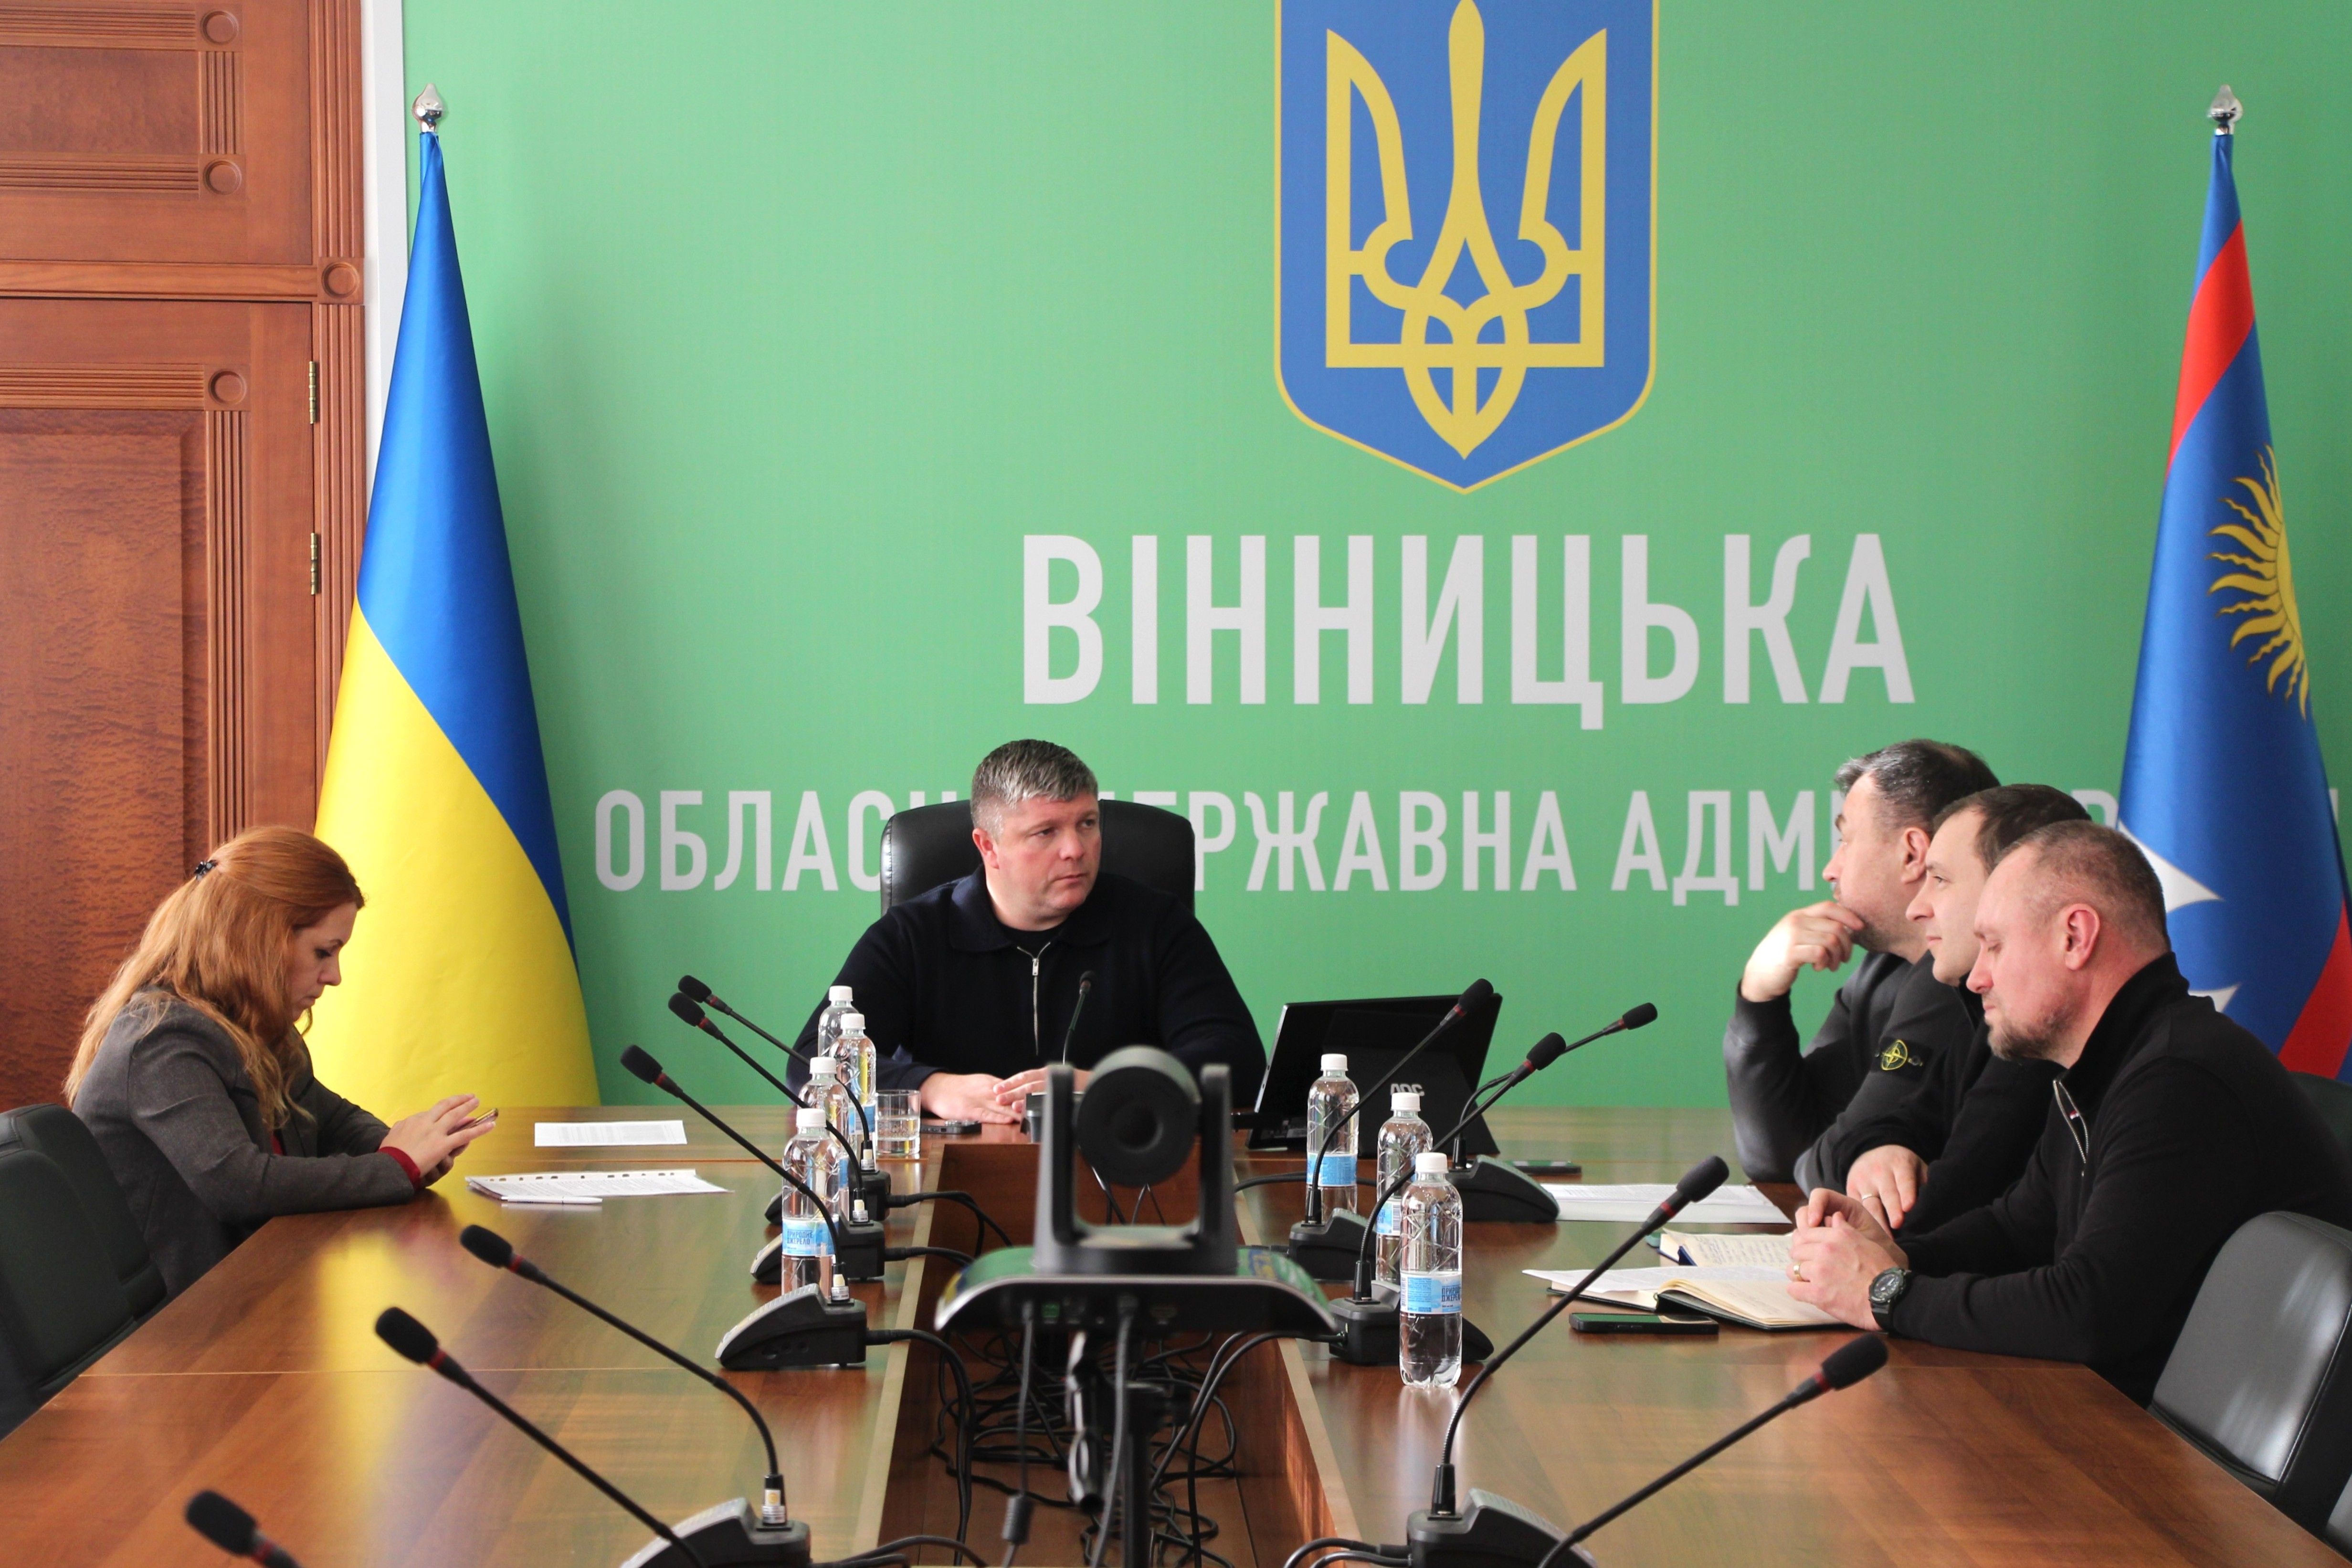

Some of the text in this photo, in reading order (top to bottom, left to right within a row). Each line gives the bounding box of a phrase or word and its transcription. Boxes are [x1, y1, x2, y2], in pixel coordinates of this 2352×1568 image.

[1023, 534, 1916, 730] ВІННИЦЬКА
[596, 789, 956, 892] ОБЛАС
[1098, 790, 1577, 891] РЖАВНА
